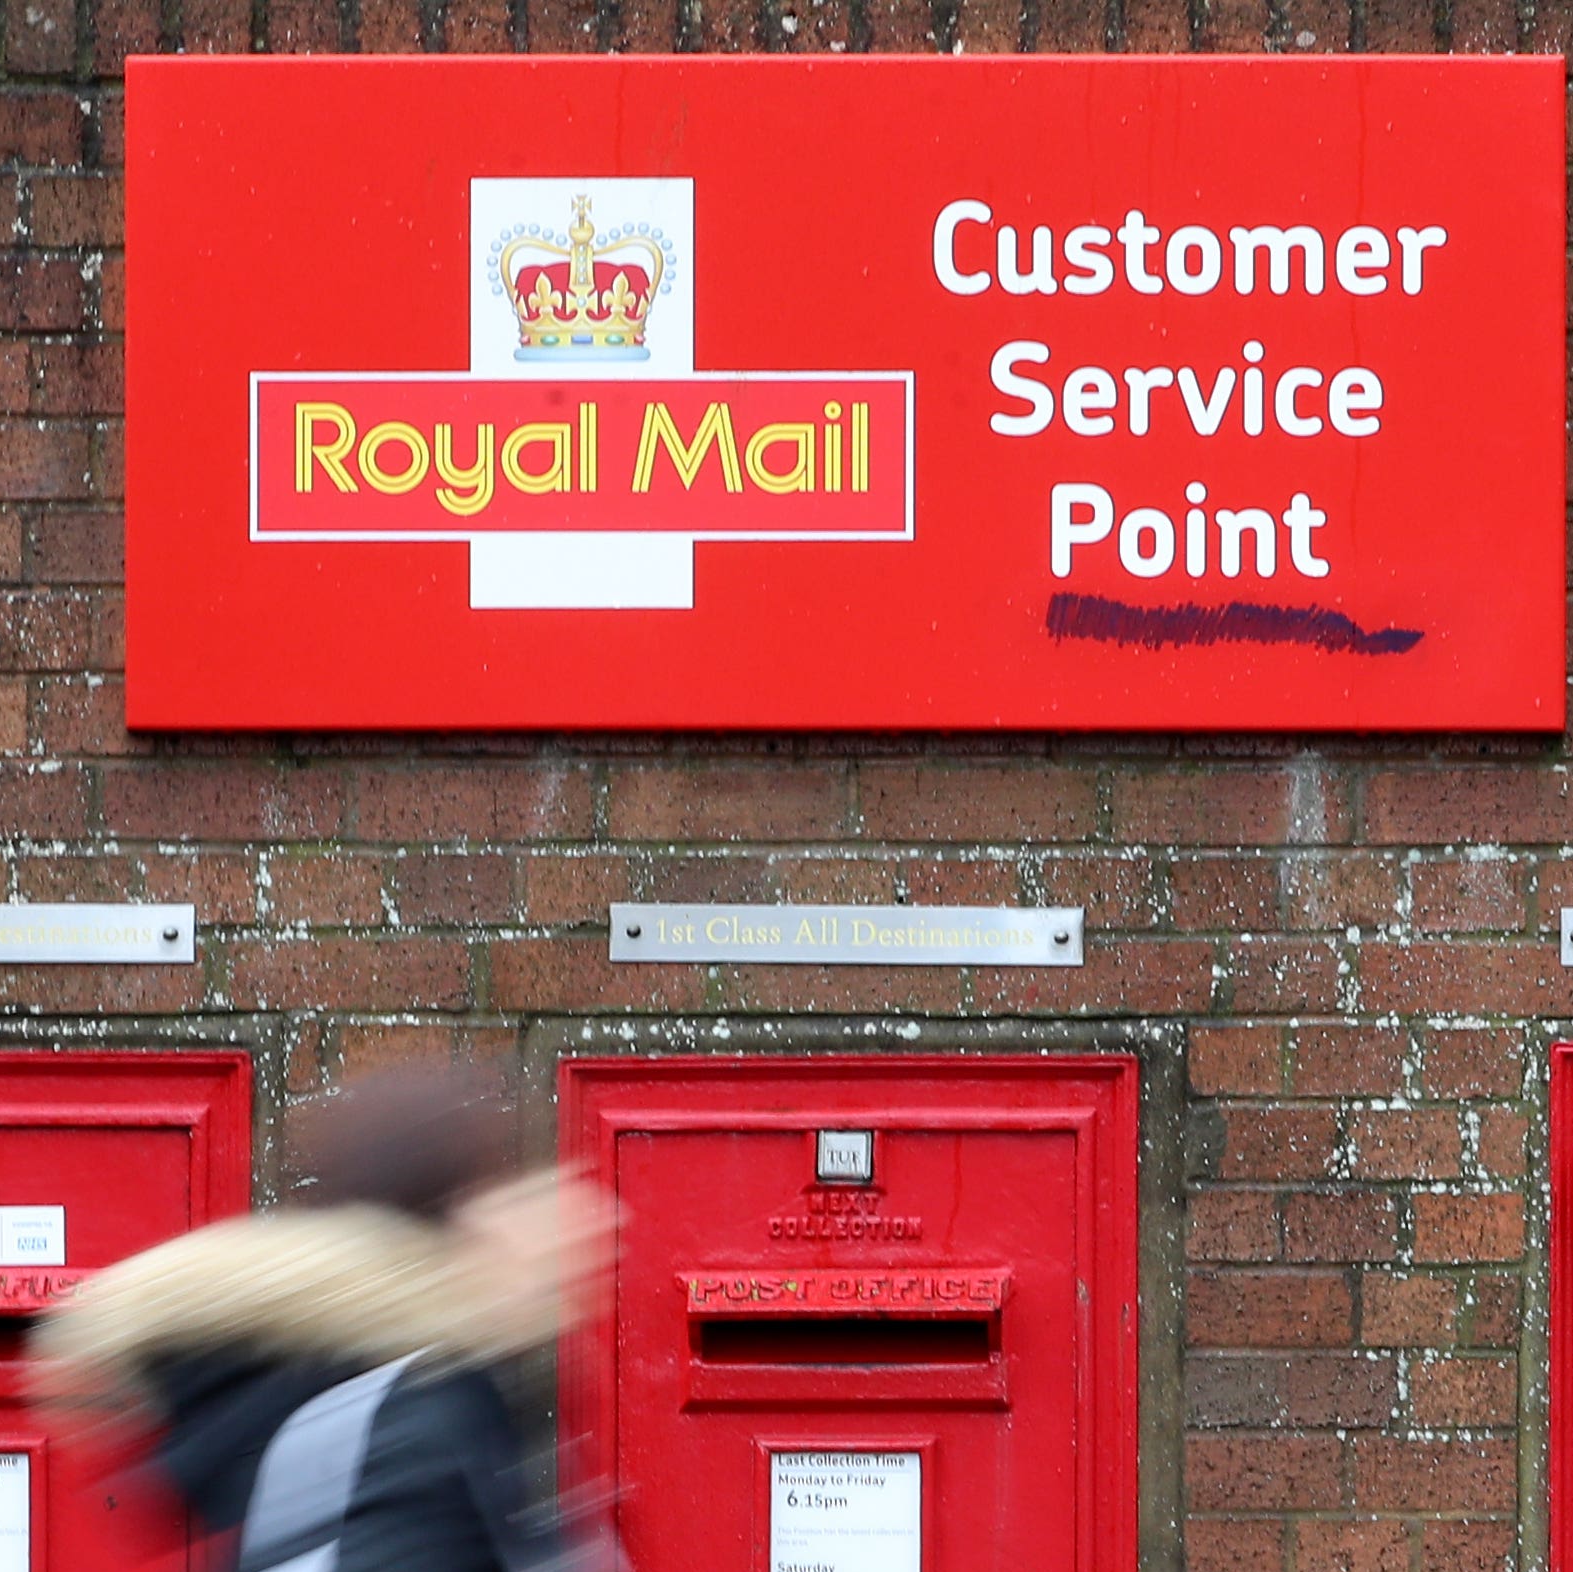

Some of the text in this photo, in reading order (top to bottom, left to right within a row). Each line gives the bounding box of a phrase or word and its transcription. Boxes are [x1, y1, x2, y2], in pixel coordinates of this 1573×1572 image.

[932, 198, 1448, 295] Customer
[988, 339, 1384, 436] Service
[294, 402, 868, 515] Royal Mail
[1050, 480, 1330, 579] Point
[655, 916, 1034, 947] 1st Class All Destinations
[807, 1193, 880, 1215] NEXT
[768, 1216, 923, 1240] COLLECTION
[690, 1275, 1005, 1302] POST OFFICE
[778, 1454, 906, 1468] Last Collection Time
[778, 1473, 887, 1488] Monday to Friday
[786, 1489, 848, 1509] 6.15pm
